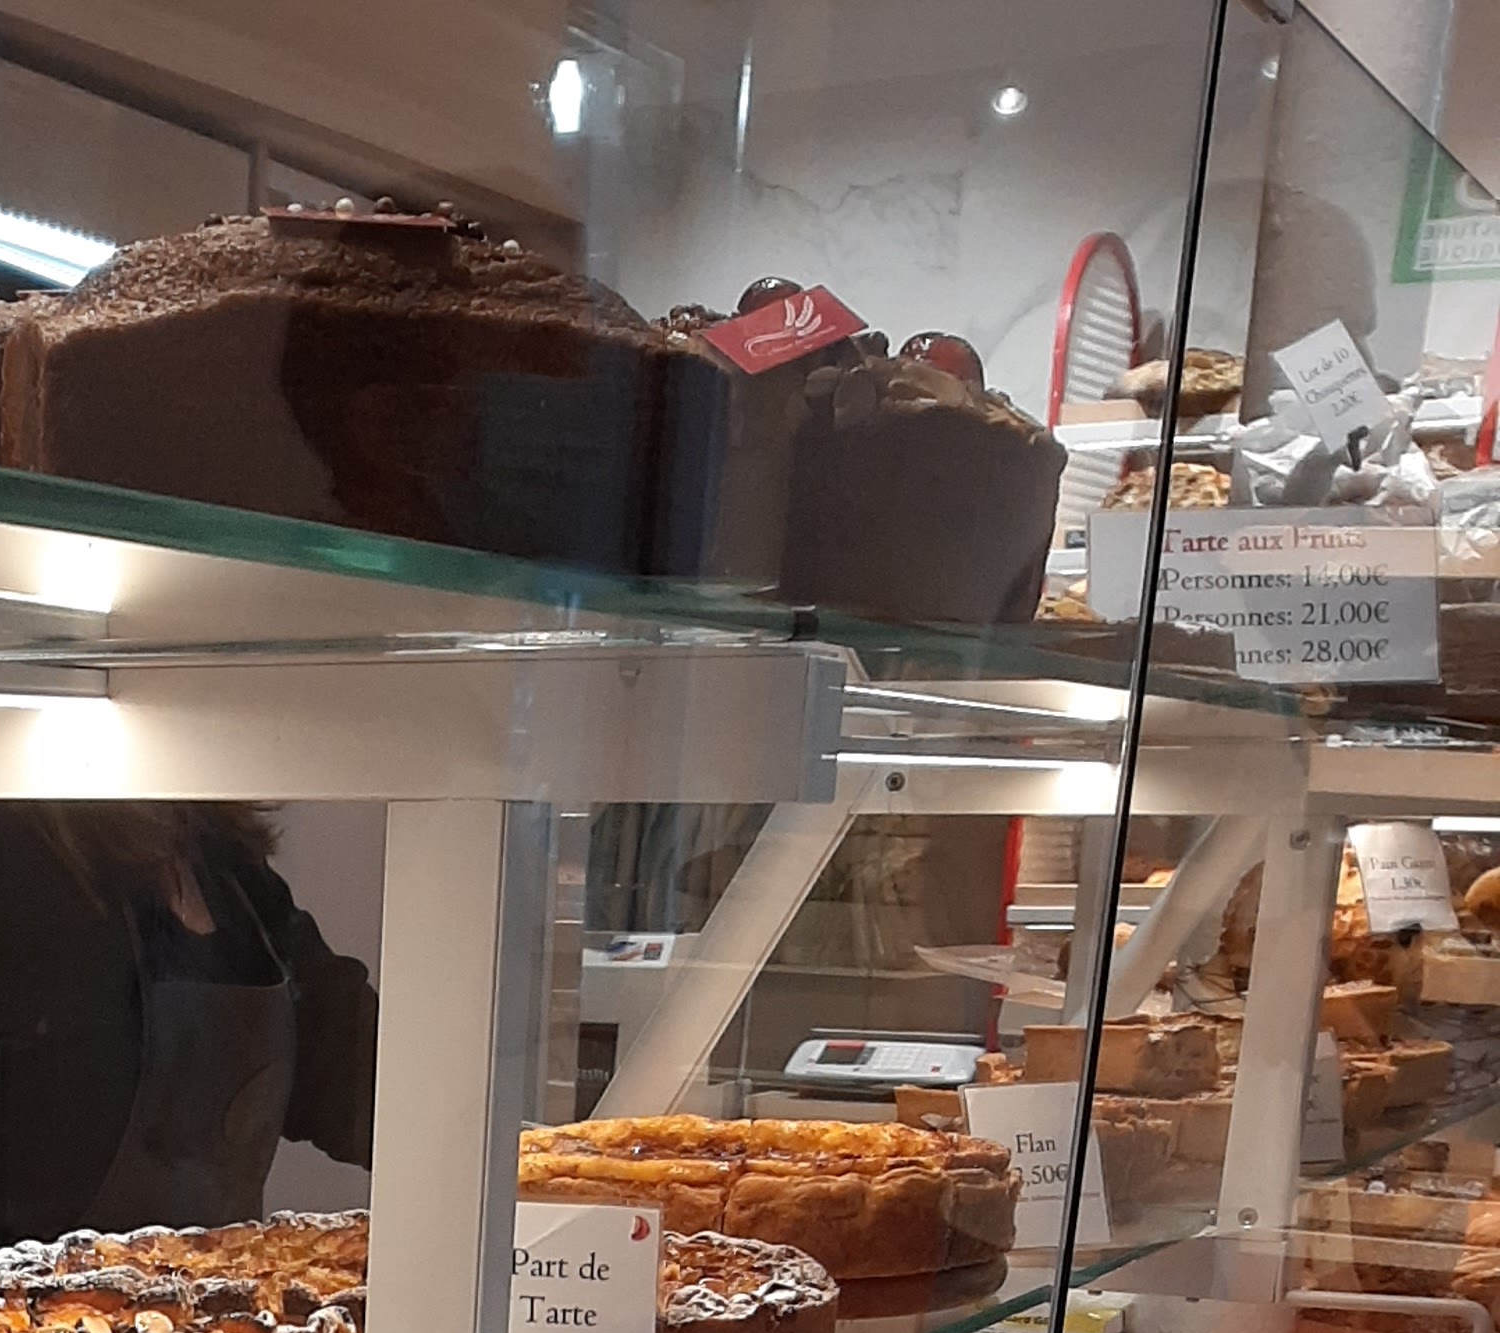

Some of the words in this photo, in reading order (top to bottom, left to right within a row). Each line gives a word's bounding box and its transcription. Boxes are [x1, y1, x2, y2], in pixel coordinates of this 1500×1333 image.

[1163, 528, 1229, 554] Tarte
[1238, 532, 1283, 551] aux
[1162, 567, 1293, 591] Personnes:
[1015, 1132, 1057, 1154] Flan
[511, 1248, 569, 1278] Part
[578, 1252, 610, 1281] de
[519, 1294, 598, 1327] Tarte
